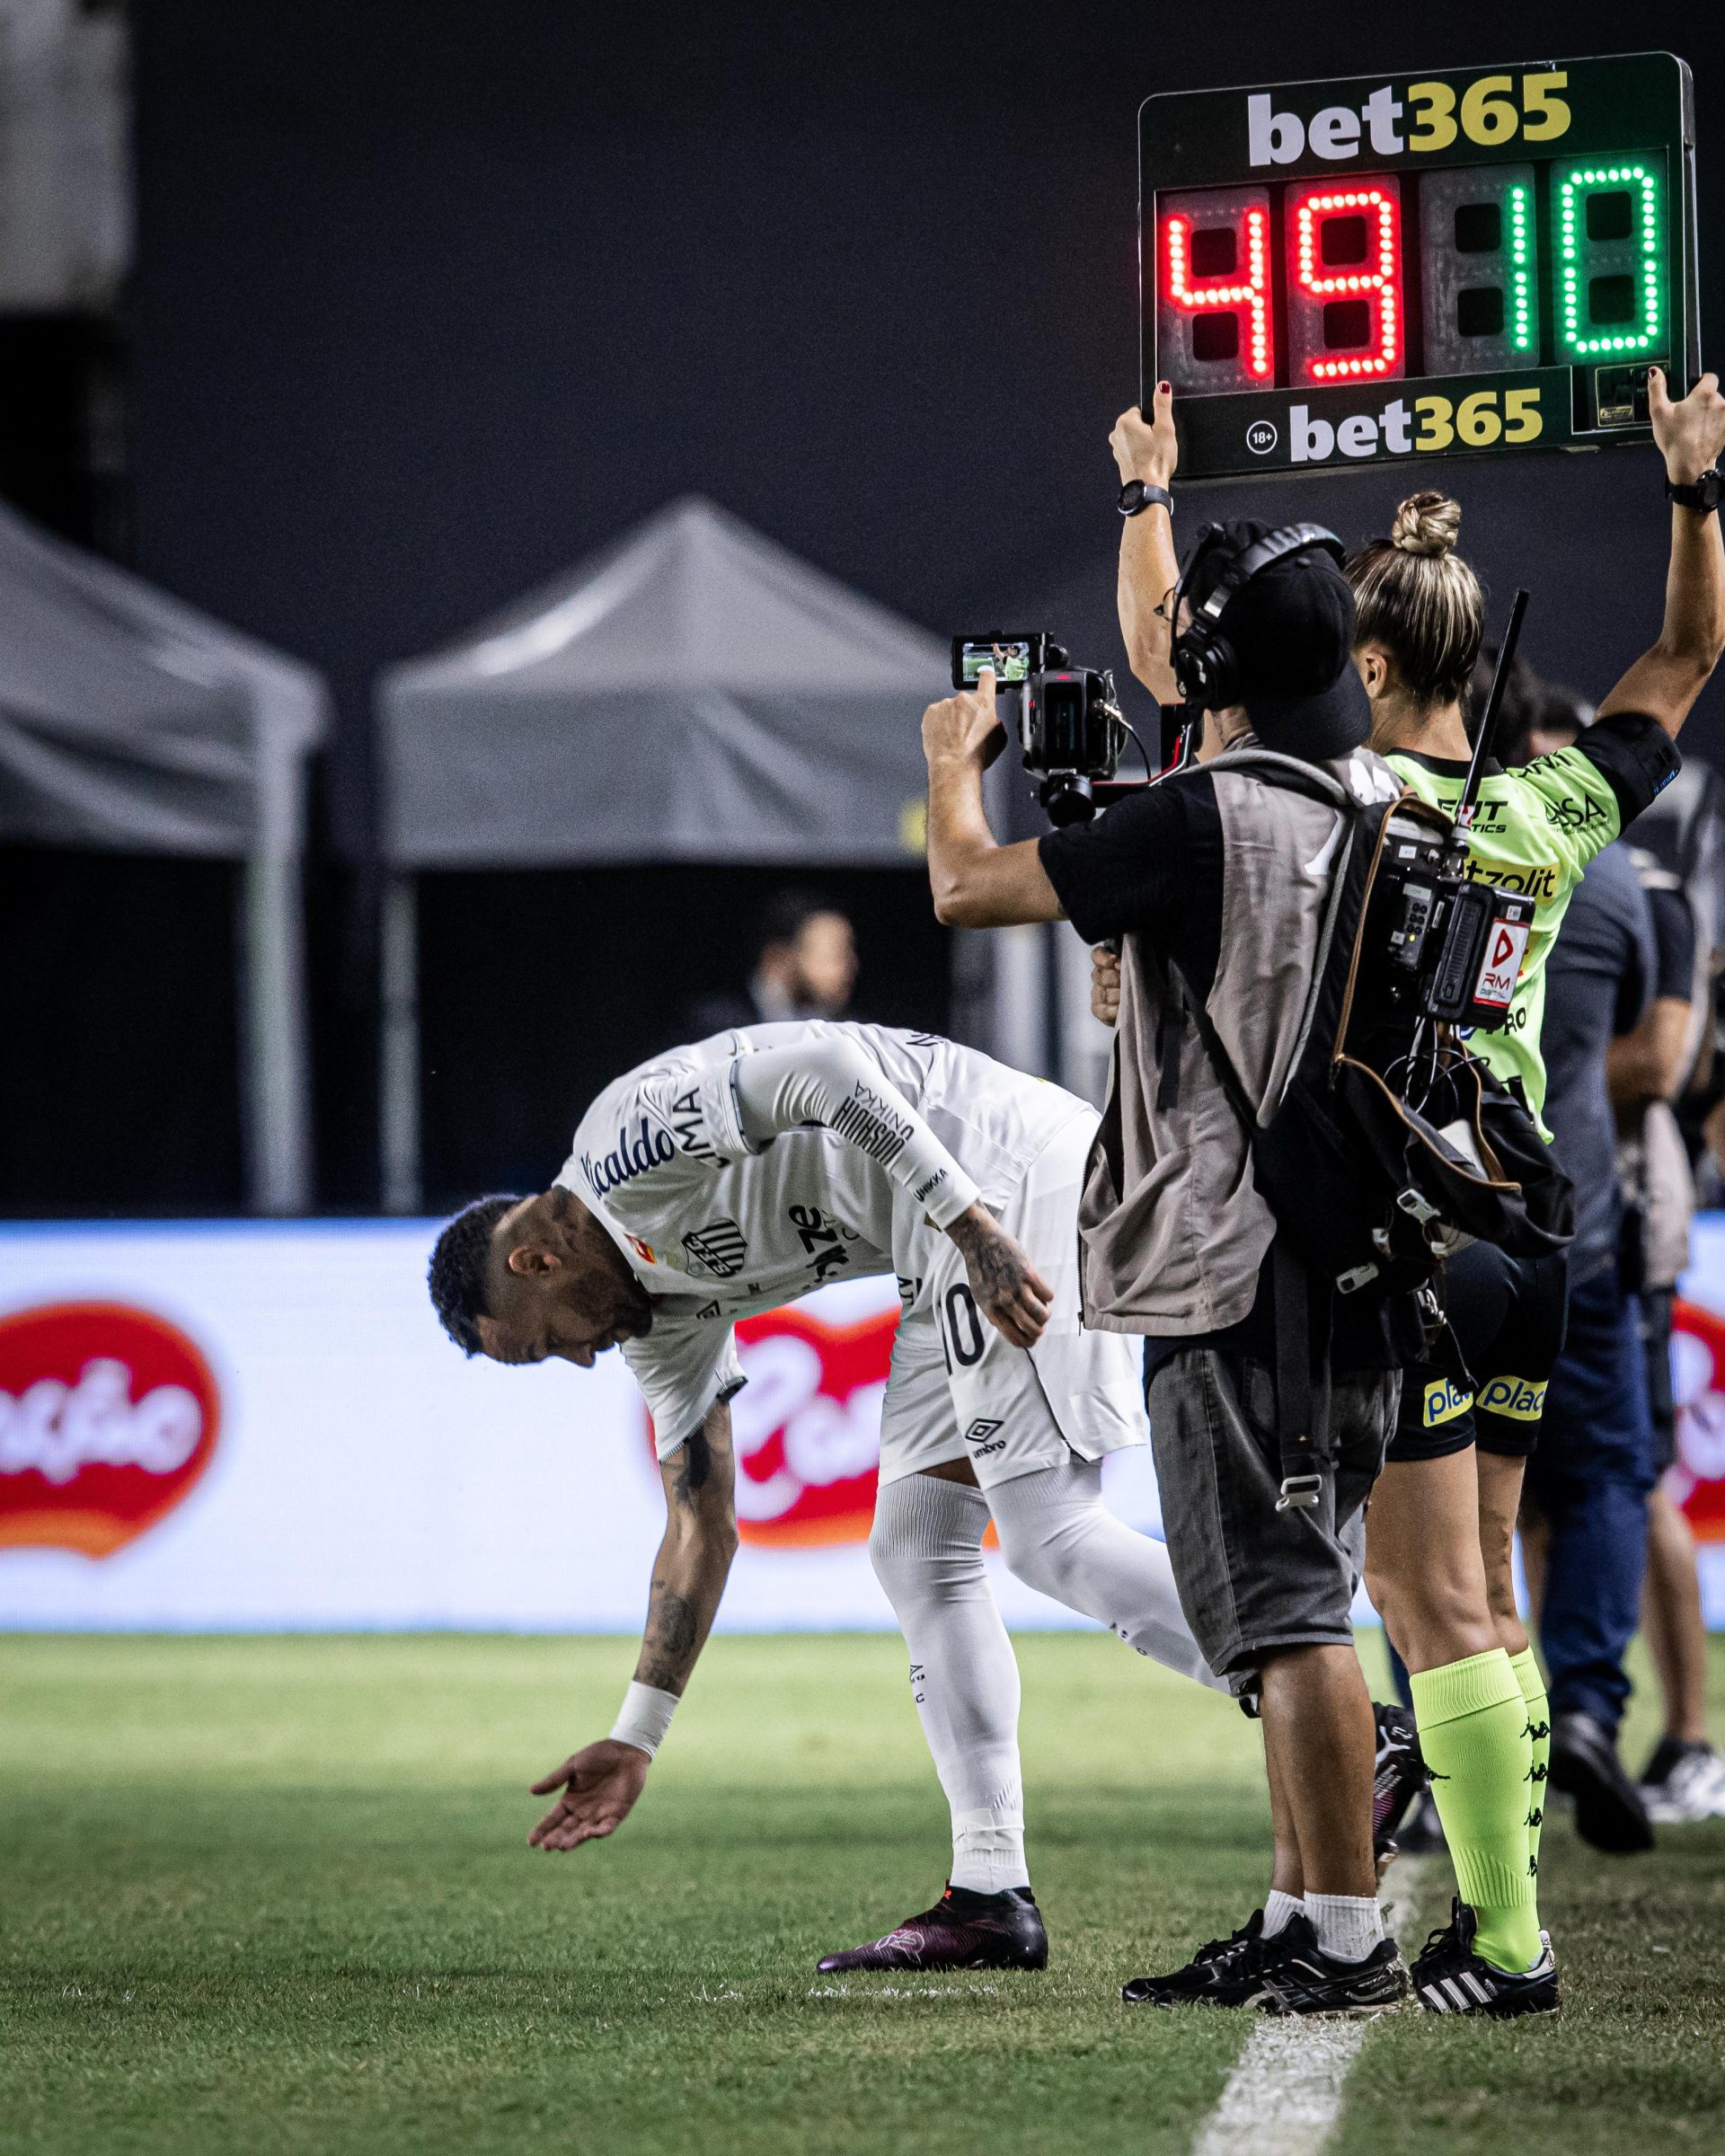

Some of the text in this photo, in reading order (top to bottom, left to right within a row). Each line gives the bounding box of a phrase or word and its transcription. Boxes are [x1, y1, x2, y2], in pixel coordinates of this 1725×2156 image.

[1247, 71, 1572, 167] bet365
[1167, 163, 1660, 377] 49 10
[1252, 387, 1544, 463] 18+ bet365
[1483, 972, 1511, 991] RM
